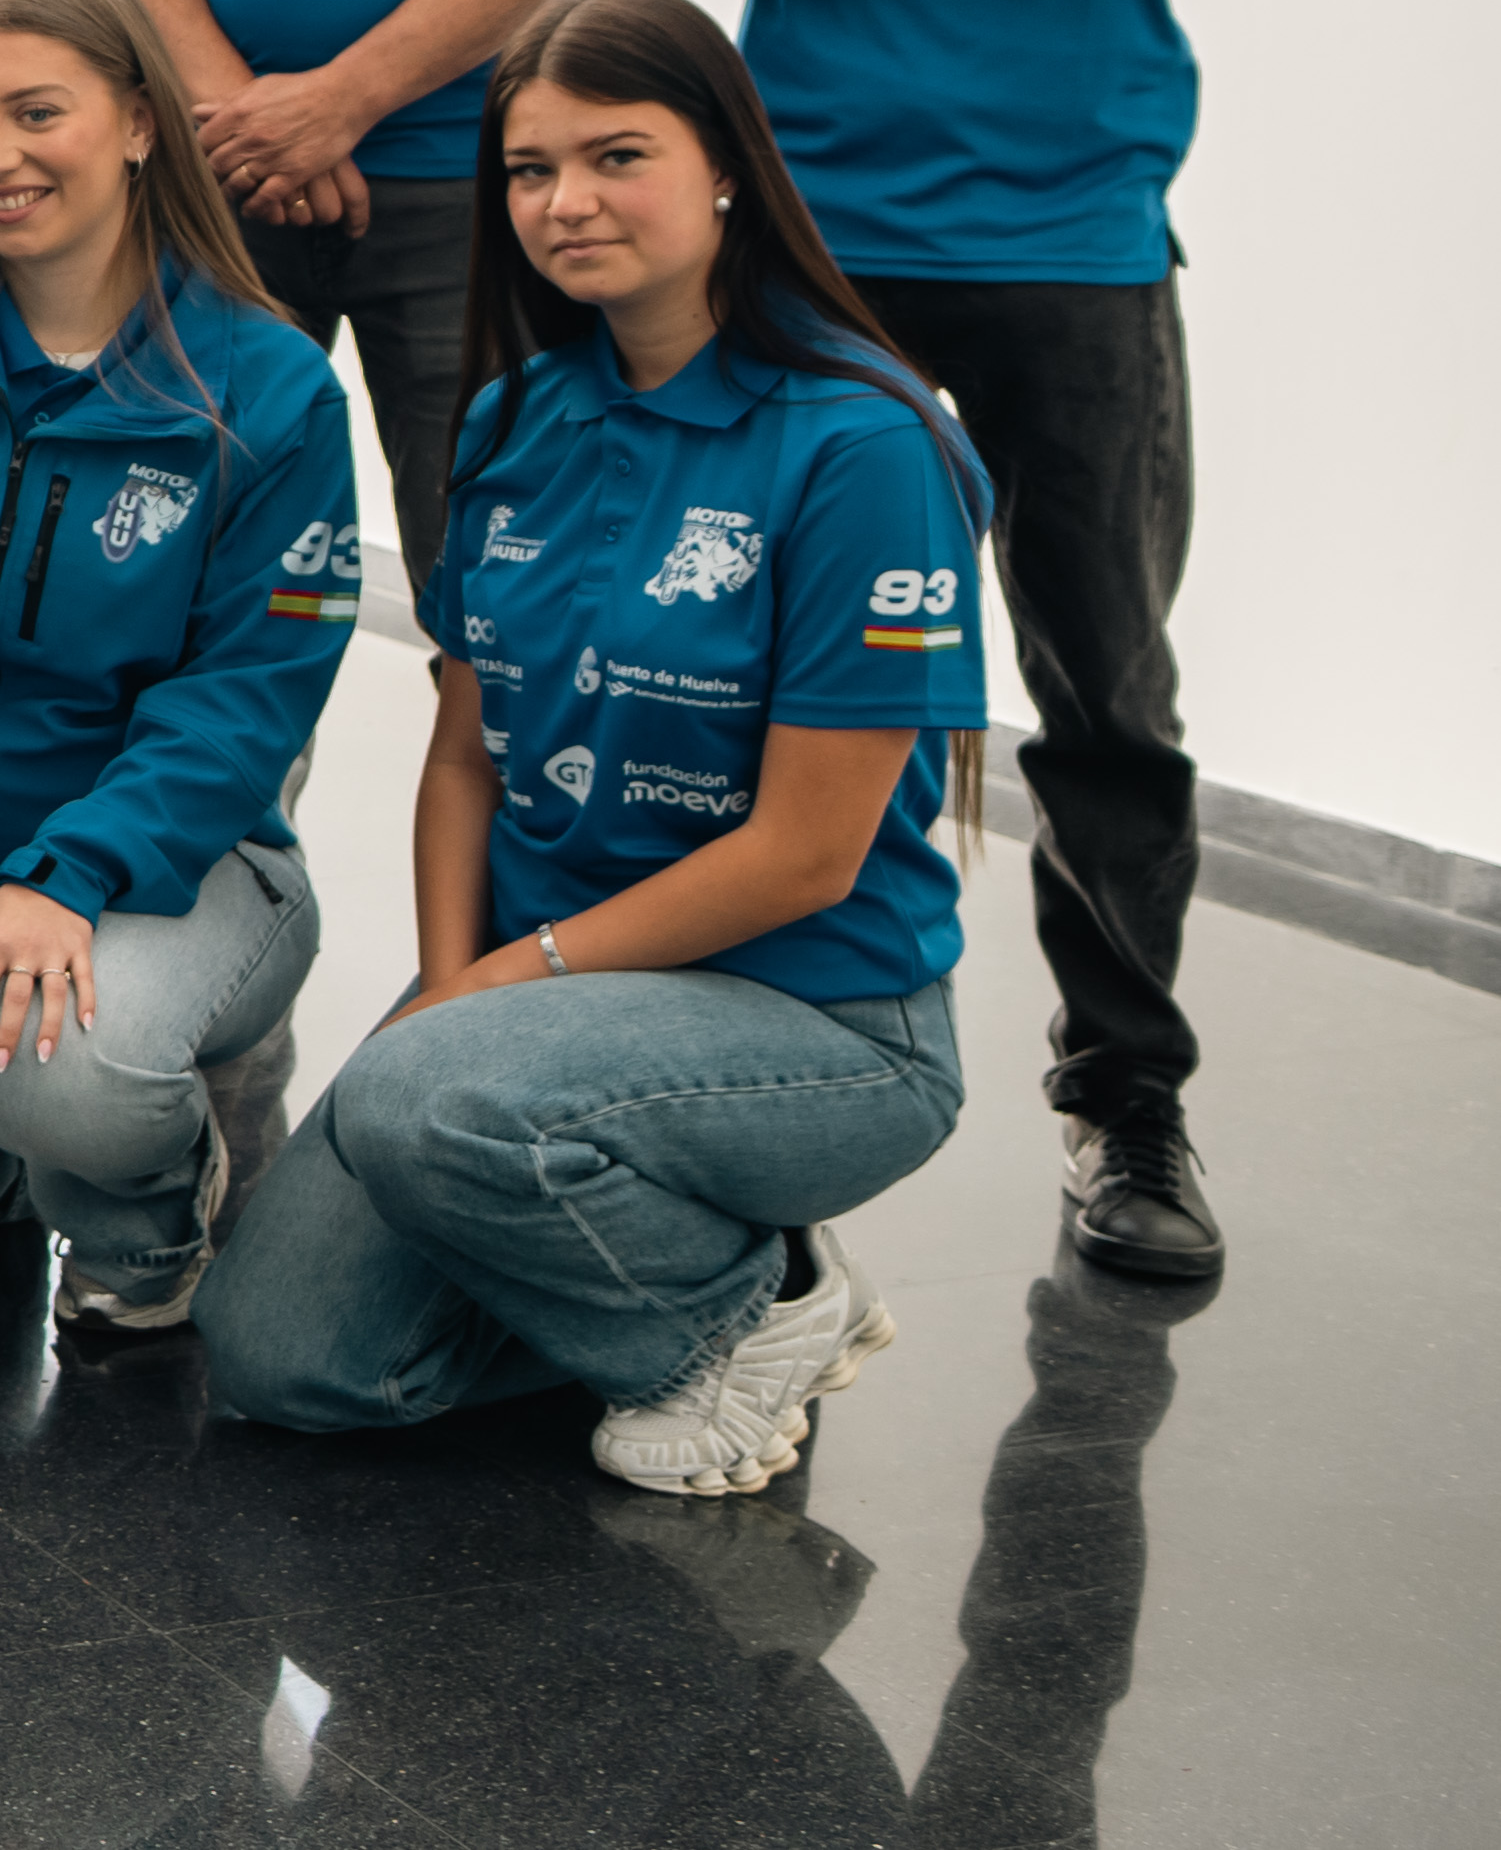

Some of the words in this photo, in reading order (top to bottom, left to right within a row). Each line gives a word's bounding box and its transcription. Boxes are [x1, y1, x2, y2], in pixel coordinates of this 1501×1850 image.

[127, 462, 186, 488] MOTO
[109, 491, 137, 547] UHU
[684, 507, 744, 528] MOTO
[281, 520, 361, 579] 93
[869, 567, 958, 616] 93
[607, 659, 651, 681] Puerto
[654, 669, 676, 686] de
[679, 674, 740, 694] Huelva
[556, 761, 592, 787] GT
[623, 759, 729, 788] fundación
[623, 781, 750, 816] moeve
